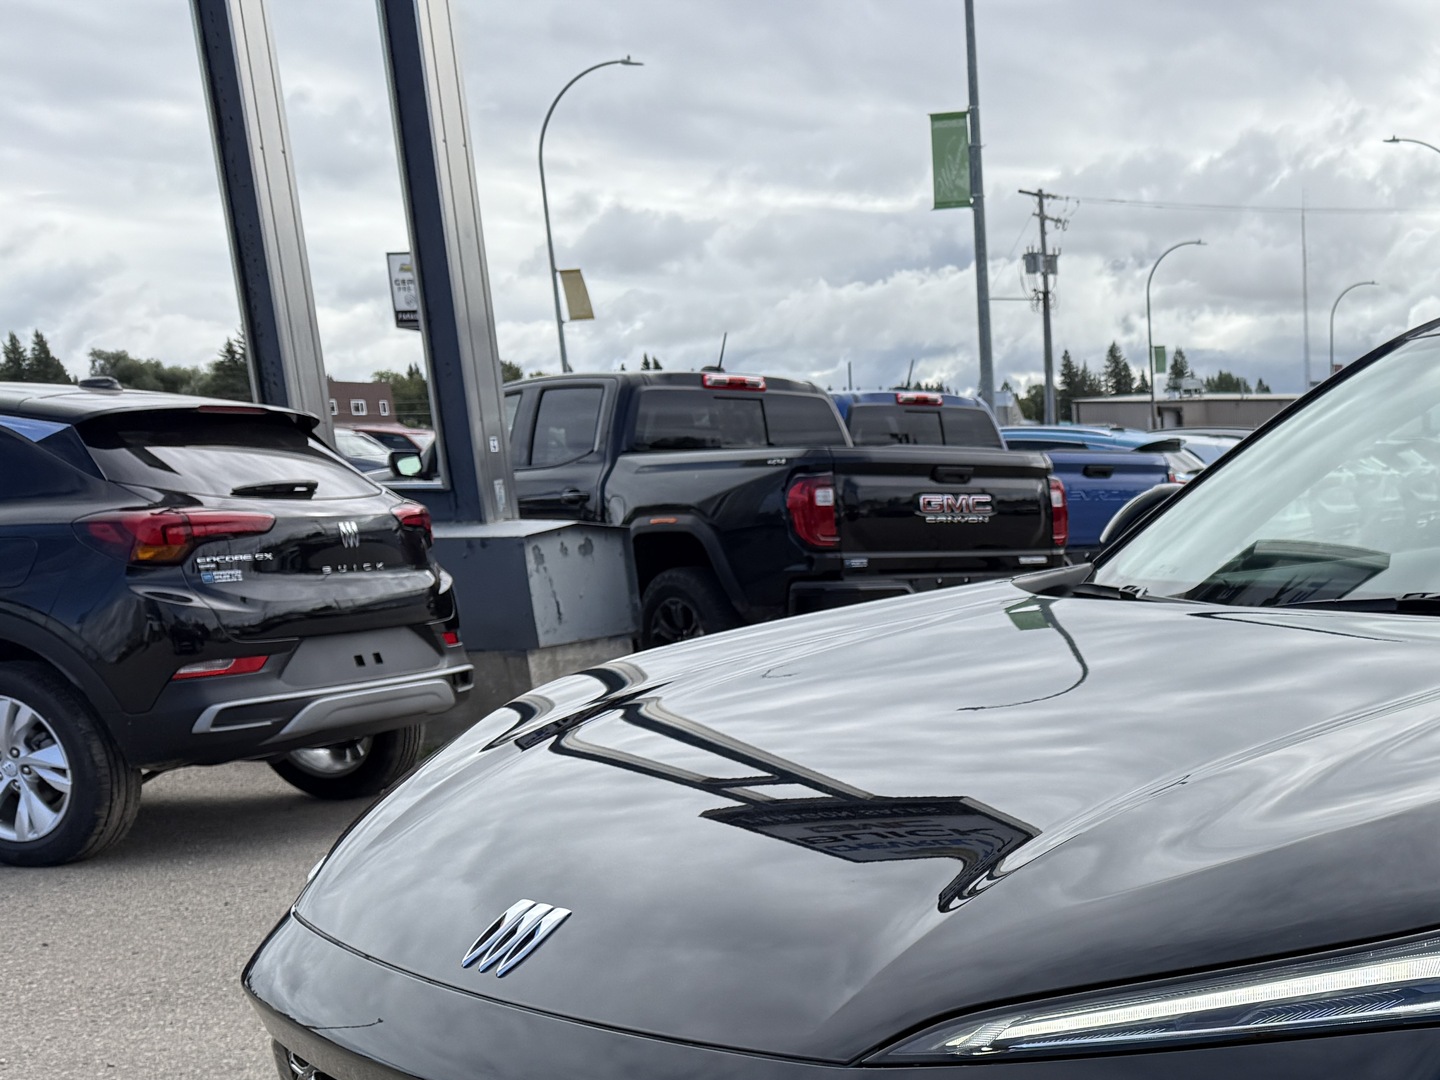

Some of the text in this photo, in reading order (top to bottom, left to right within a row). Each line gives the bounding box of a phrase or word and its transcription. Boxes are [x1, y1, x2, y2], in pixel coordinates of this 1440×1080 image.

[919, 493, 992, 514] GMC
[925, 516, 990, 524] CANYON
[321, 562, 385, 576] BUICK
